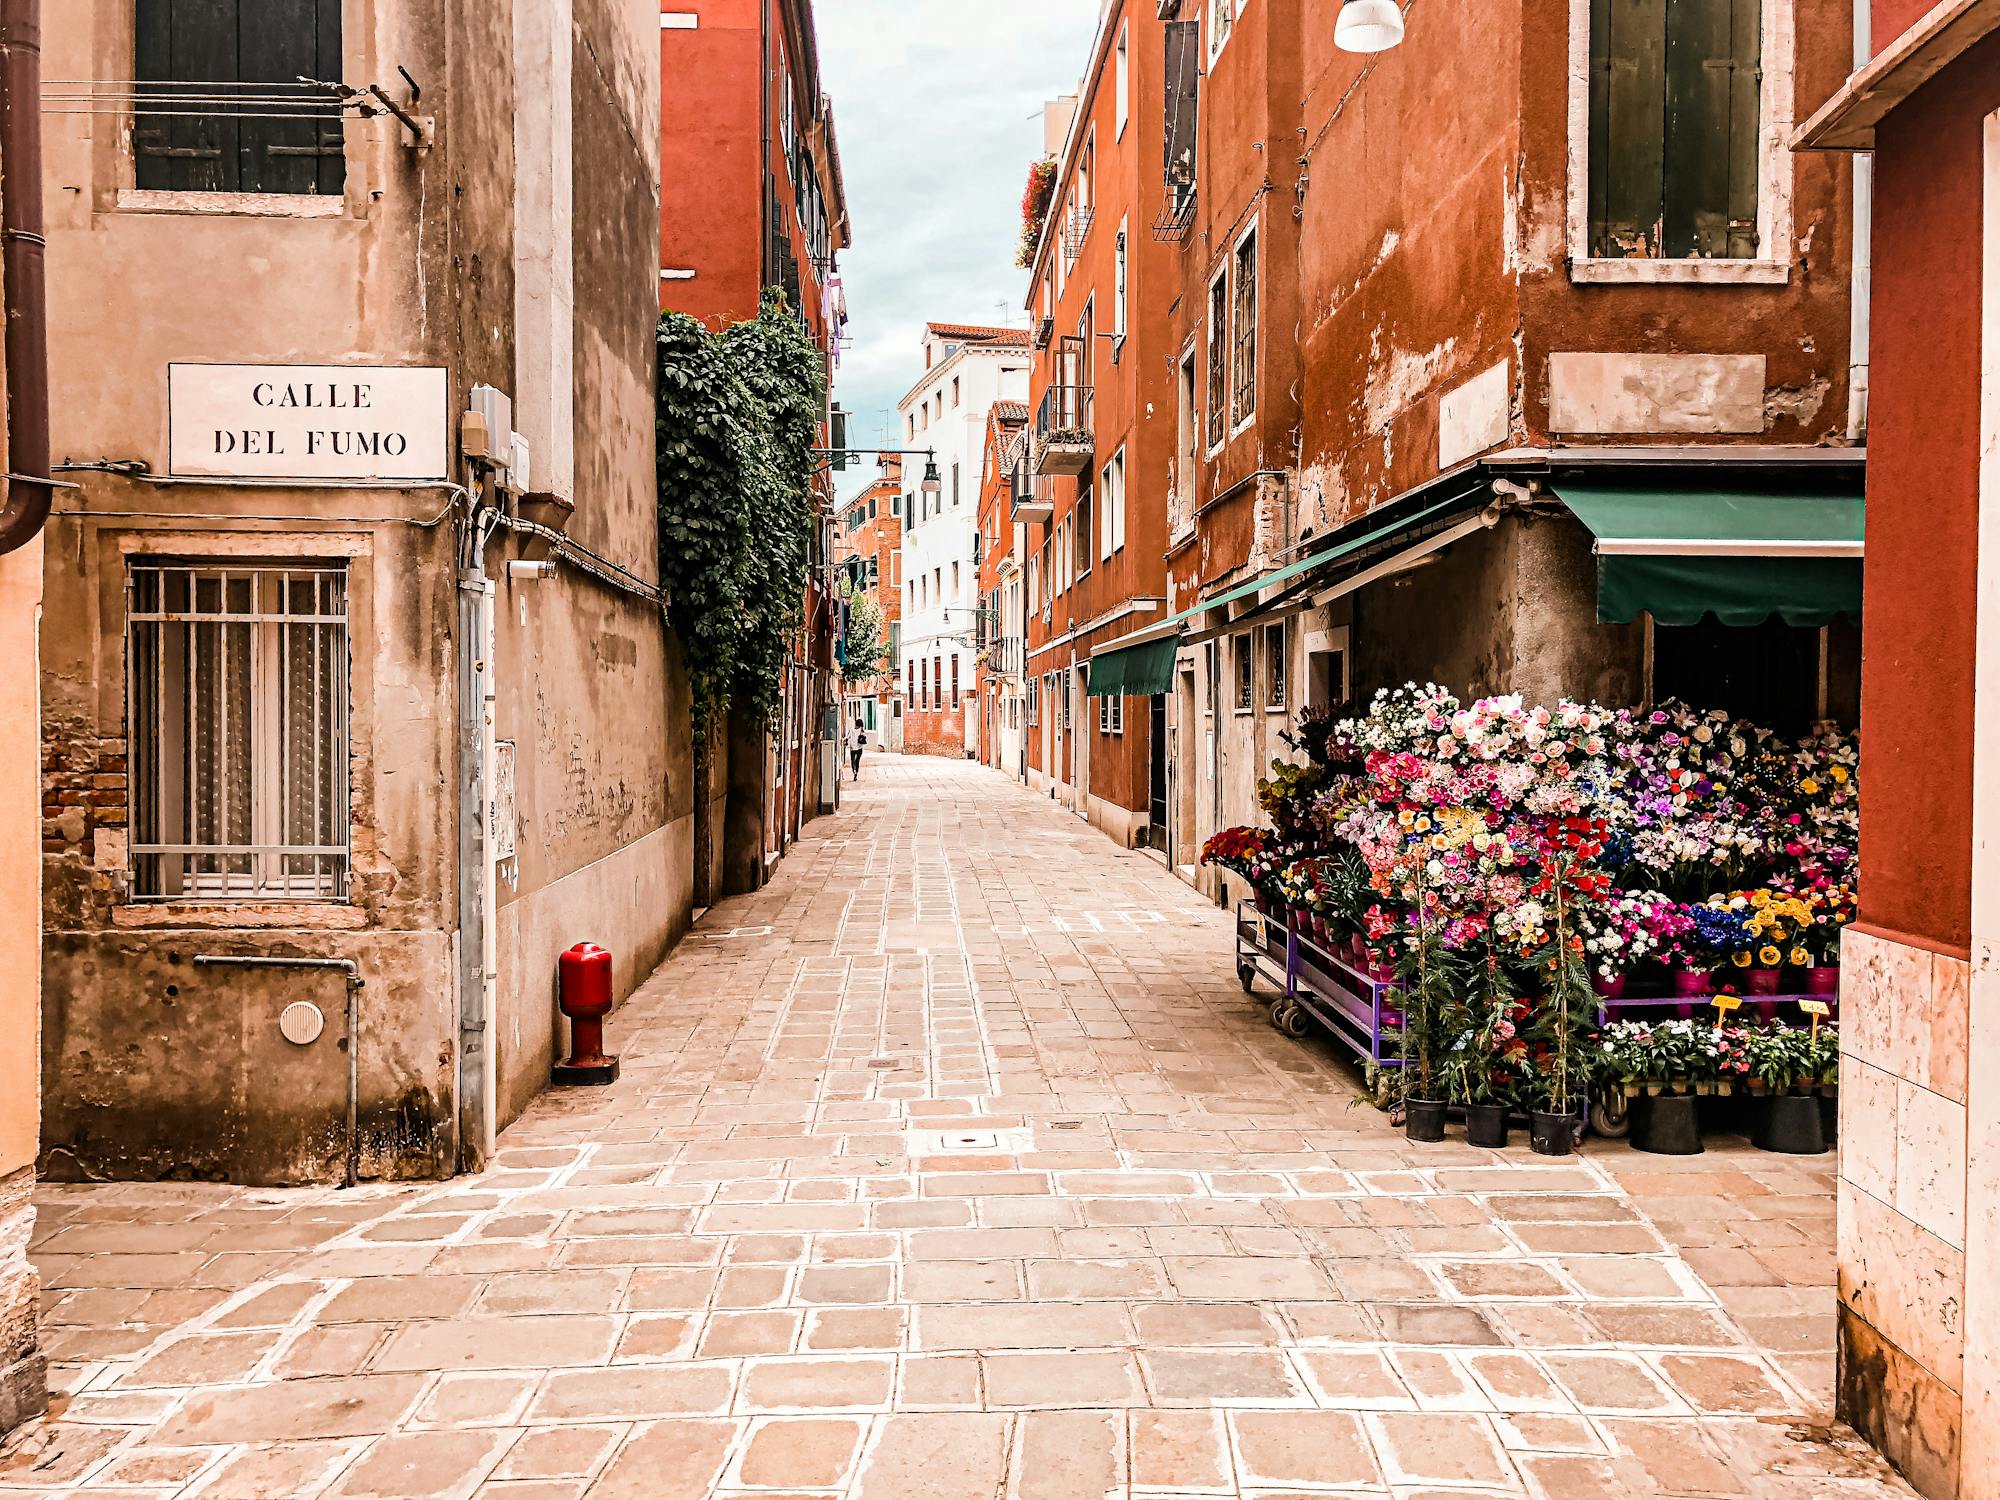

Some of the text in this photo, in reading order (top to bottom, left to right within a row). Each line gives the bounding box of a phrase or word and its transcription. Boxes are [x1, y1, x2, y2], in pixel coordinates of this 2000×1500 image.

[253, 383, 372, 408] CALLE
[214, 430, 407, 456] DEL FUMO
